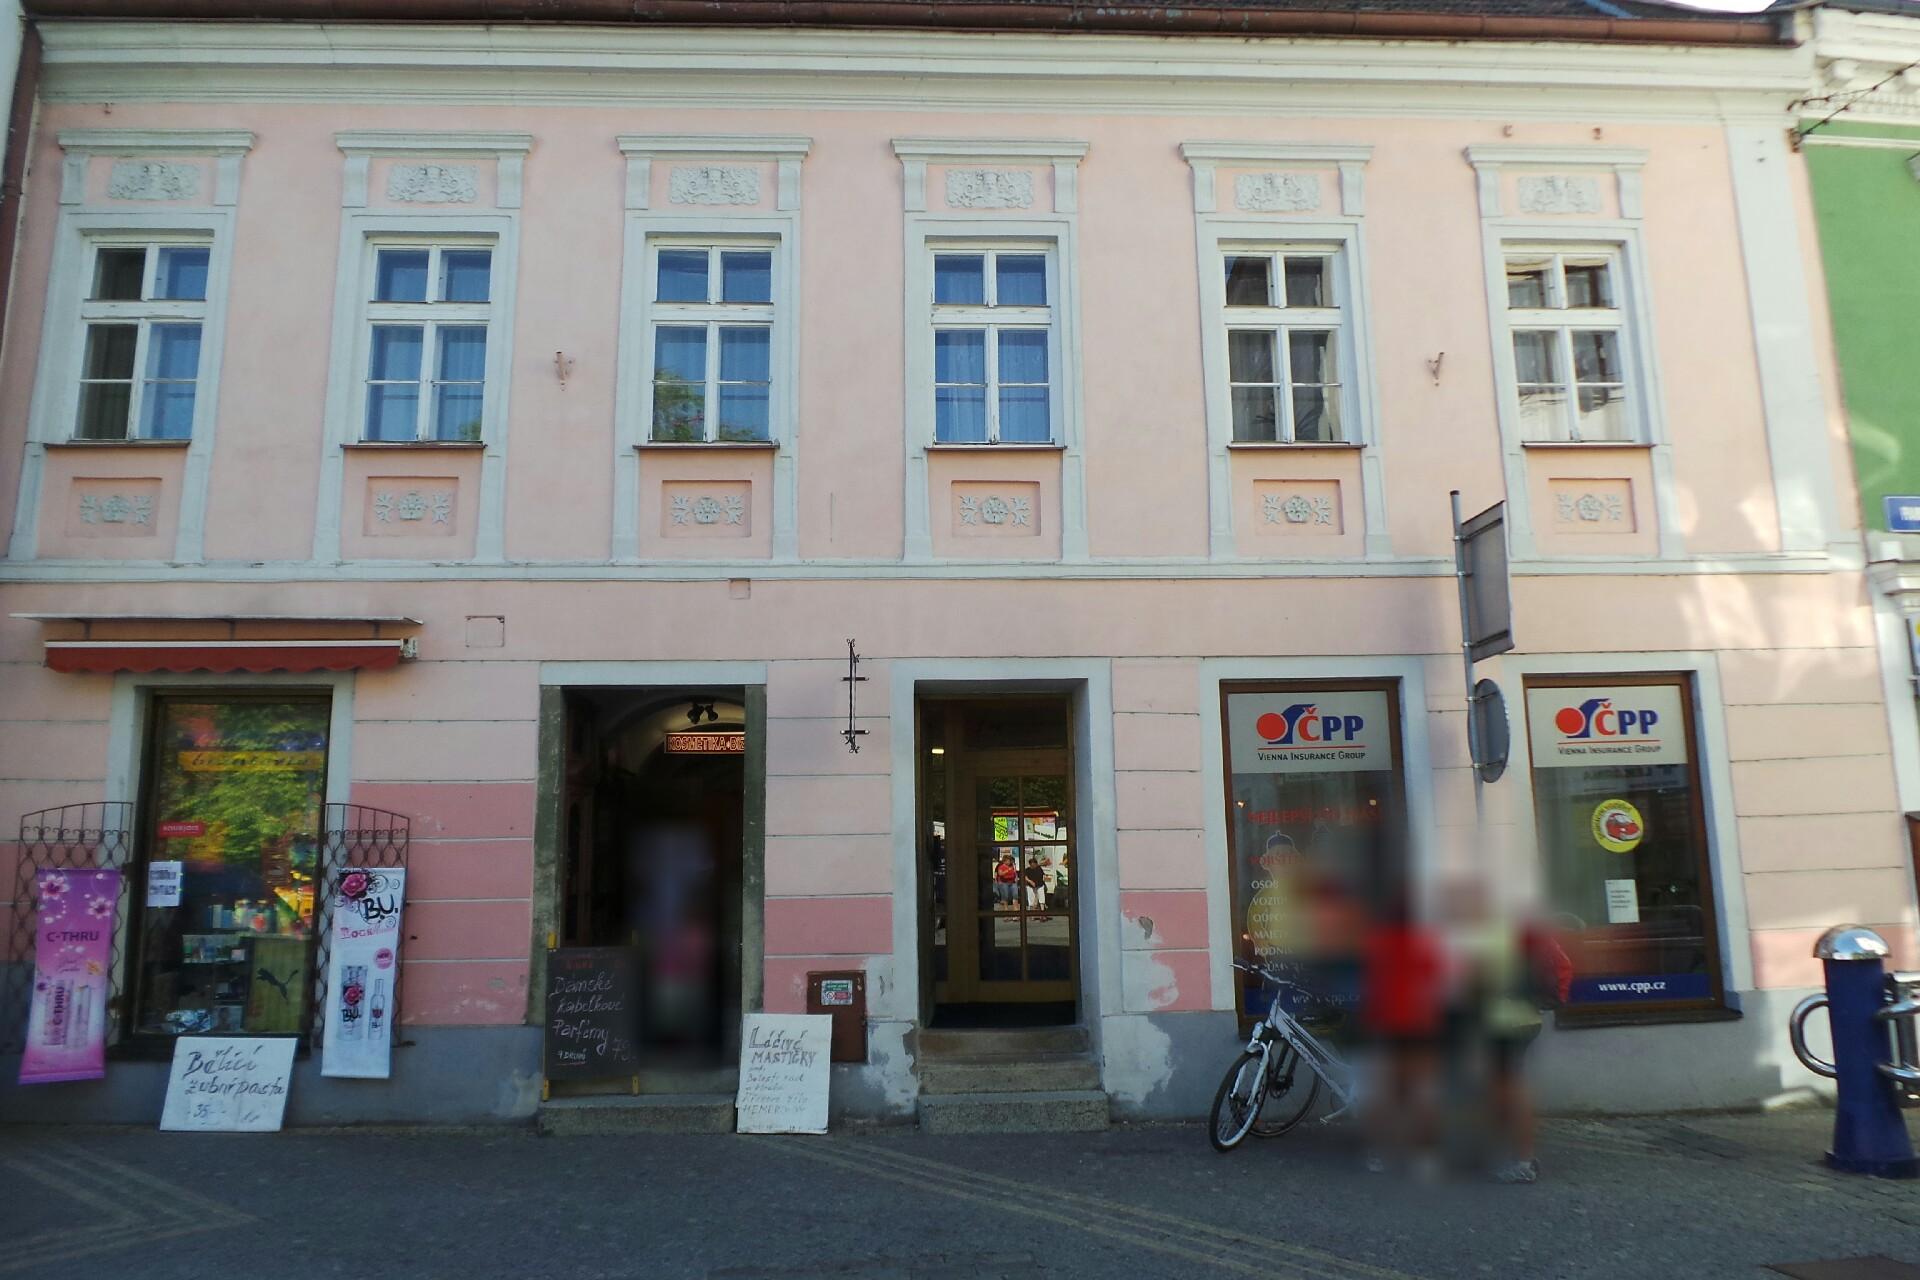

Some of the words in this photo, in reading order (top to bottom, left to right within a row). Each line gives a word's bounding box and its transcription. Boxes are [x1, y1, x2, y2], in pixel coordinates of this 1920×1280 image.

[1298, 707, 1364, 741] ČPP
[1594, 702, 1659, 736] ČPP
[46, 931, 100, 942] C-THRU
[1599, 981, 1666, 993] www.cpp.cz
